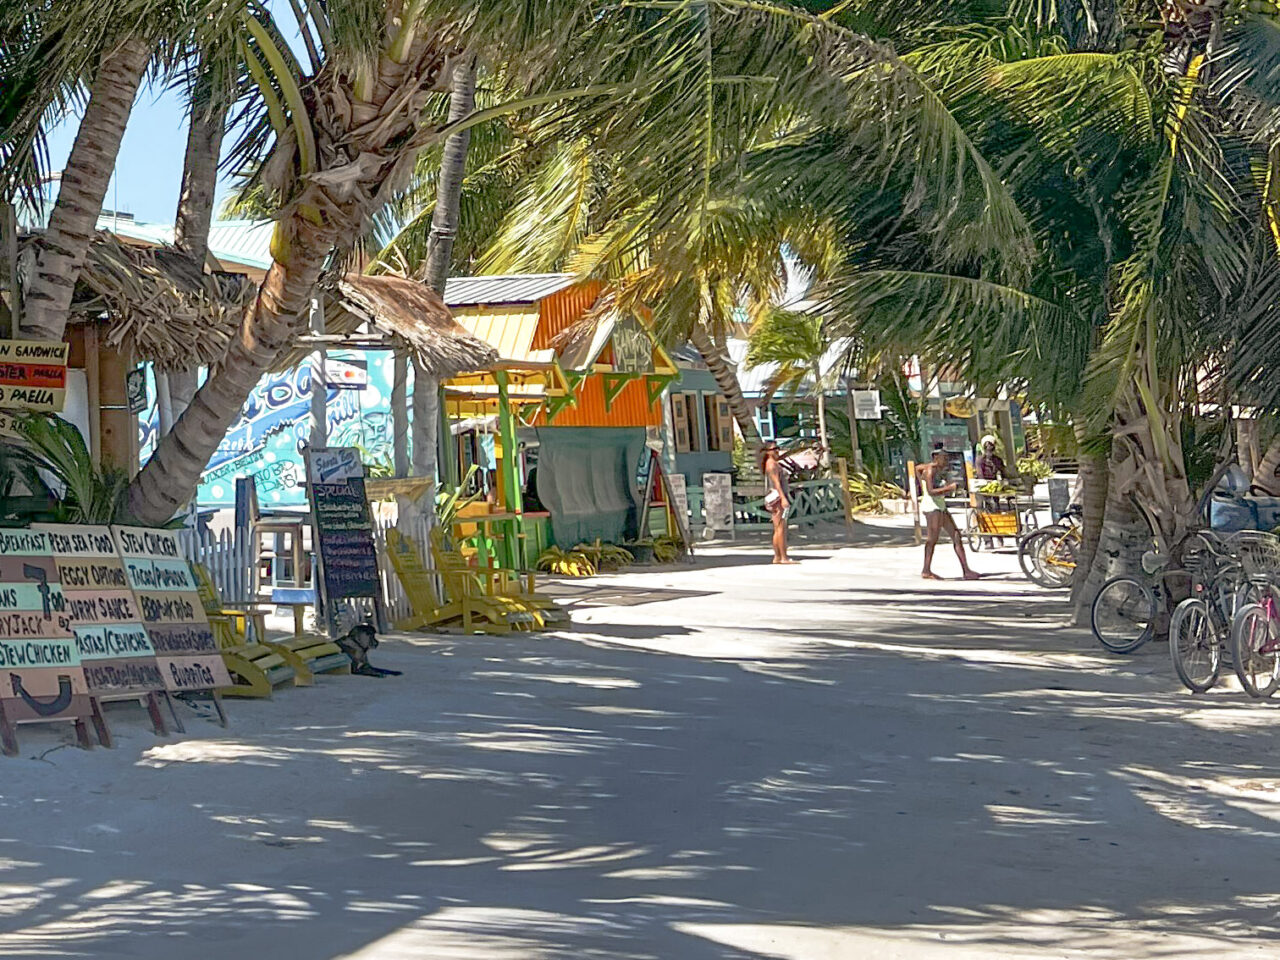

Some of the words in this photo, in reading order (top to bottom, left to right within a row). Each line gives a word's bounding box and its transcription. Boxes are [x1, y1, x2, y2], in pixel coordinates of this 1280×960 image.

[15, 346, 66, 359] SANDWICH
[10, 389, 54, 406] PAELLA
[71, 534, 89, 552] SEA
[86, 534, 114, 554] FOOD
[121, 530, 145, 553] STEW
[91, 564, 126, 586] OPTIONS
[98, 596, 134, 620] SAUCE
